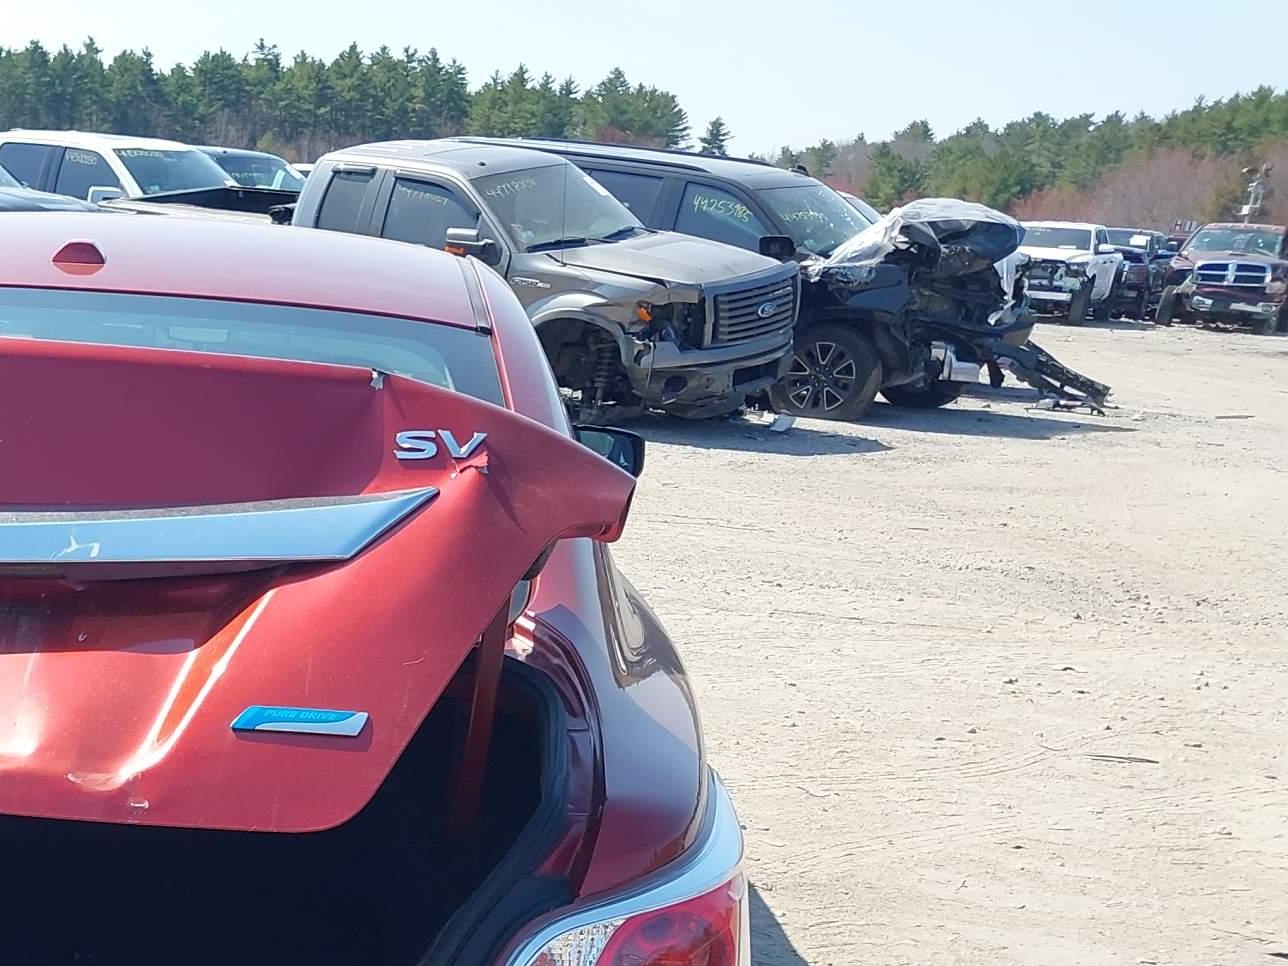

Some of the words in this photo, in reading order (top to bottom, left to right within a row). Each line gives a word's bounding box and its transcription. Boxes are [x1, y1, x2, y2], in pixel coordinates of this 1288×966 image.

[393, 429, 489, 460] SV
[264, 708, 298, 719] PURE
[300, 710, 337, 720] DRIVE
